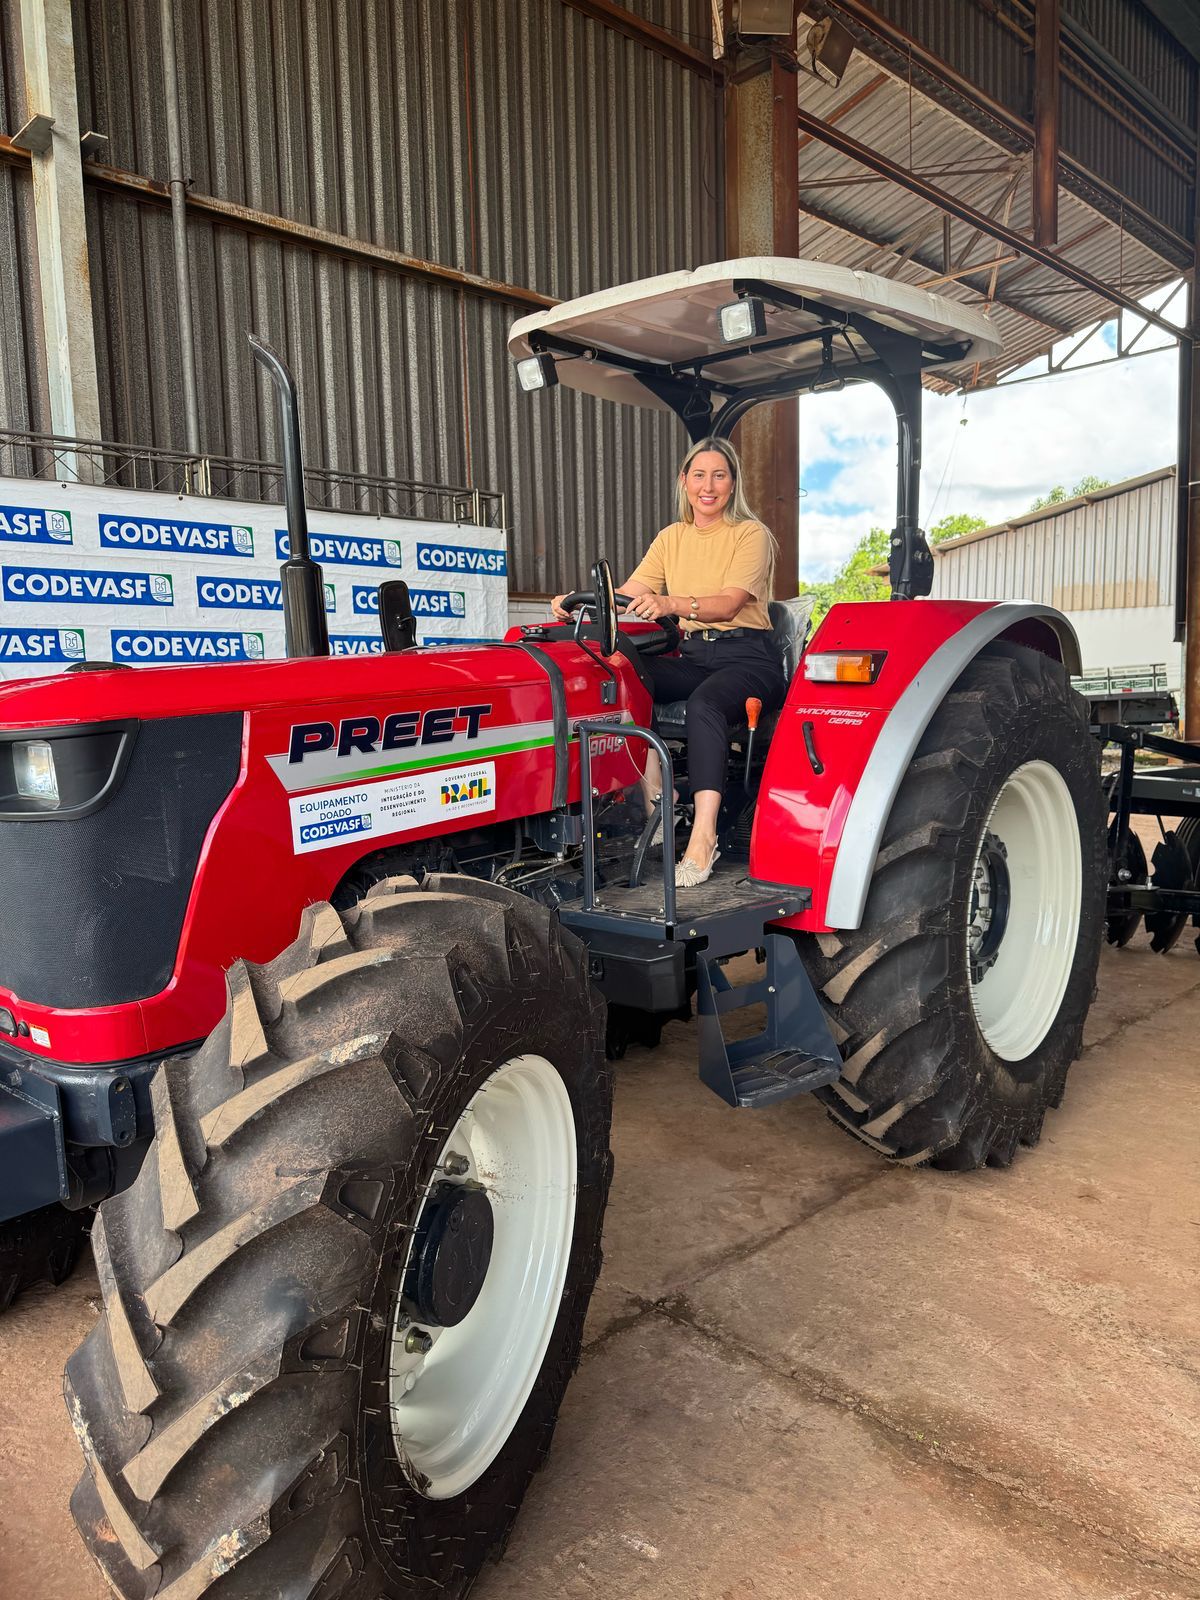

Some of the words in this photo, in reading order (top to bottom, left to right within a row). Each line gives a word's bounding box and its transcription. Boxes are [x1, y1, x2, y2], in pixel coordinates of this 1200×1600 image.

[103, 521, 229, 550] CODEVASF
[278, 535, 382, 561] CDEVASF
[419, 548, 504, 571] CODEVASF
[7, 573, 147, 599] CODEVASF
[115, 636, 240, 657] CODEVASF
[796, 707, 871, 718] SYNCHROMESH
[828, 717, 864, 725] GEARS
[287, 703, 493, 764] PREET
[445, 773, 467, 782] GOVERNO
[468, 769, 488, 777] FEDERAL
[381, 791, 413, 803] INTEGRAÇÃO
[441, 777, 492, 806] BRASIL
[300, 793, 368, 814] EQUIPAMENTO
[320, 807, 352, 821] DOADO
[380, 797, 427, 812] DESENVOLVIMENTO
[392, 807, 417, 817] REGIONAL
[302, 818, 361, 840] CODEVASF
